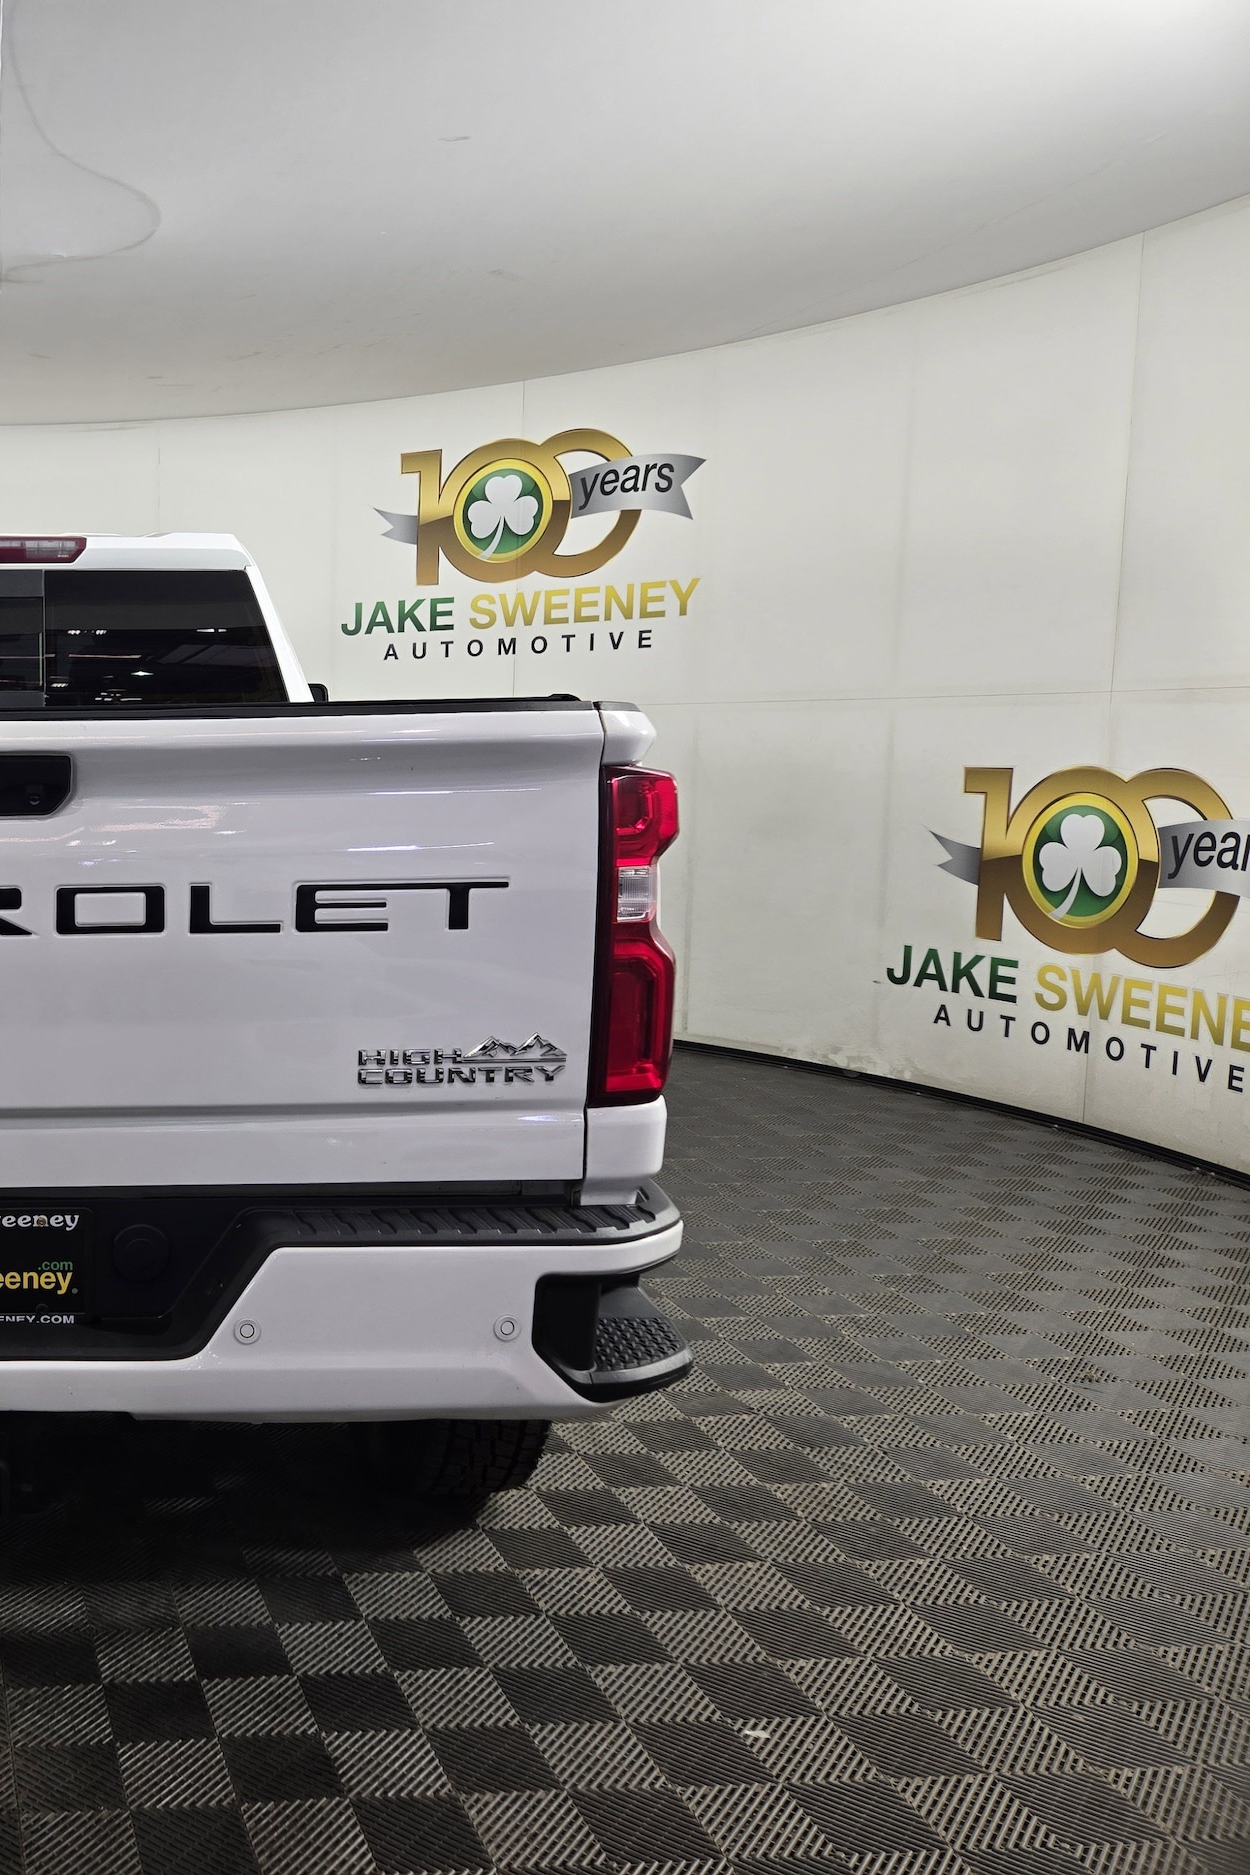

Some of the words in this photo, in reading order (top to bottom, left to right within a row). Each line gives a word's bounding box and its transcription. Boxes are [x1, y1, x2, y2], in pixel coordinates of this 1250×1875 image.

[400, 428, 642, 586] 100
[578, 462, 675, 510] years
[341, 597, 455, 637] JAKE
[468, 578, 702, 630] SWEENEY
[383, 630, 653, 660] AUTOMOTIVE
[963, 766, 1241, 969] 100
[1167, 831, 1250, 880] year
[886, 945, 1020, 1004] JAKE
[1034, 964, 1250, 1053] SWEENE
[358, 1048, 463, 1066] HIGH
[358, 1065, 565, 1084] COUNTRY
[933, 1004, 1245, 1093] AUTOMOTIVE
